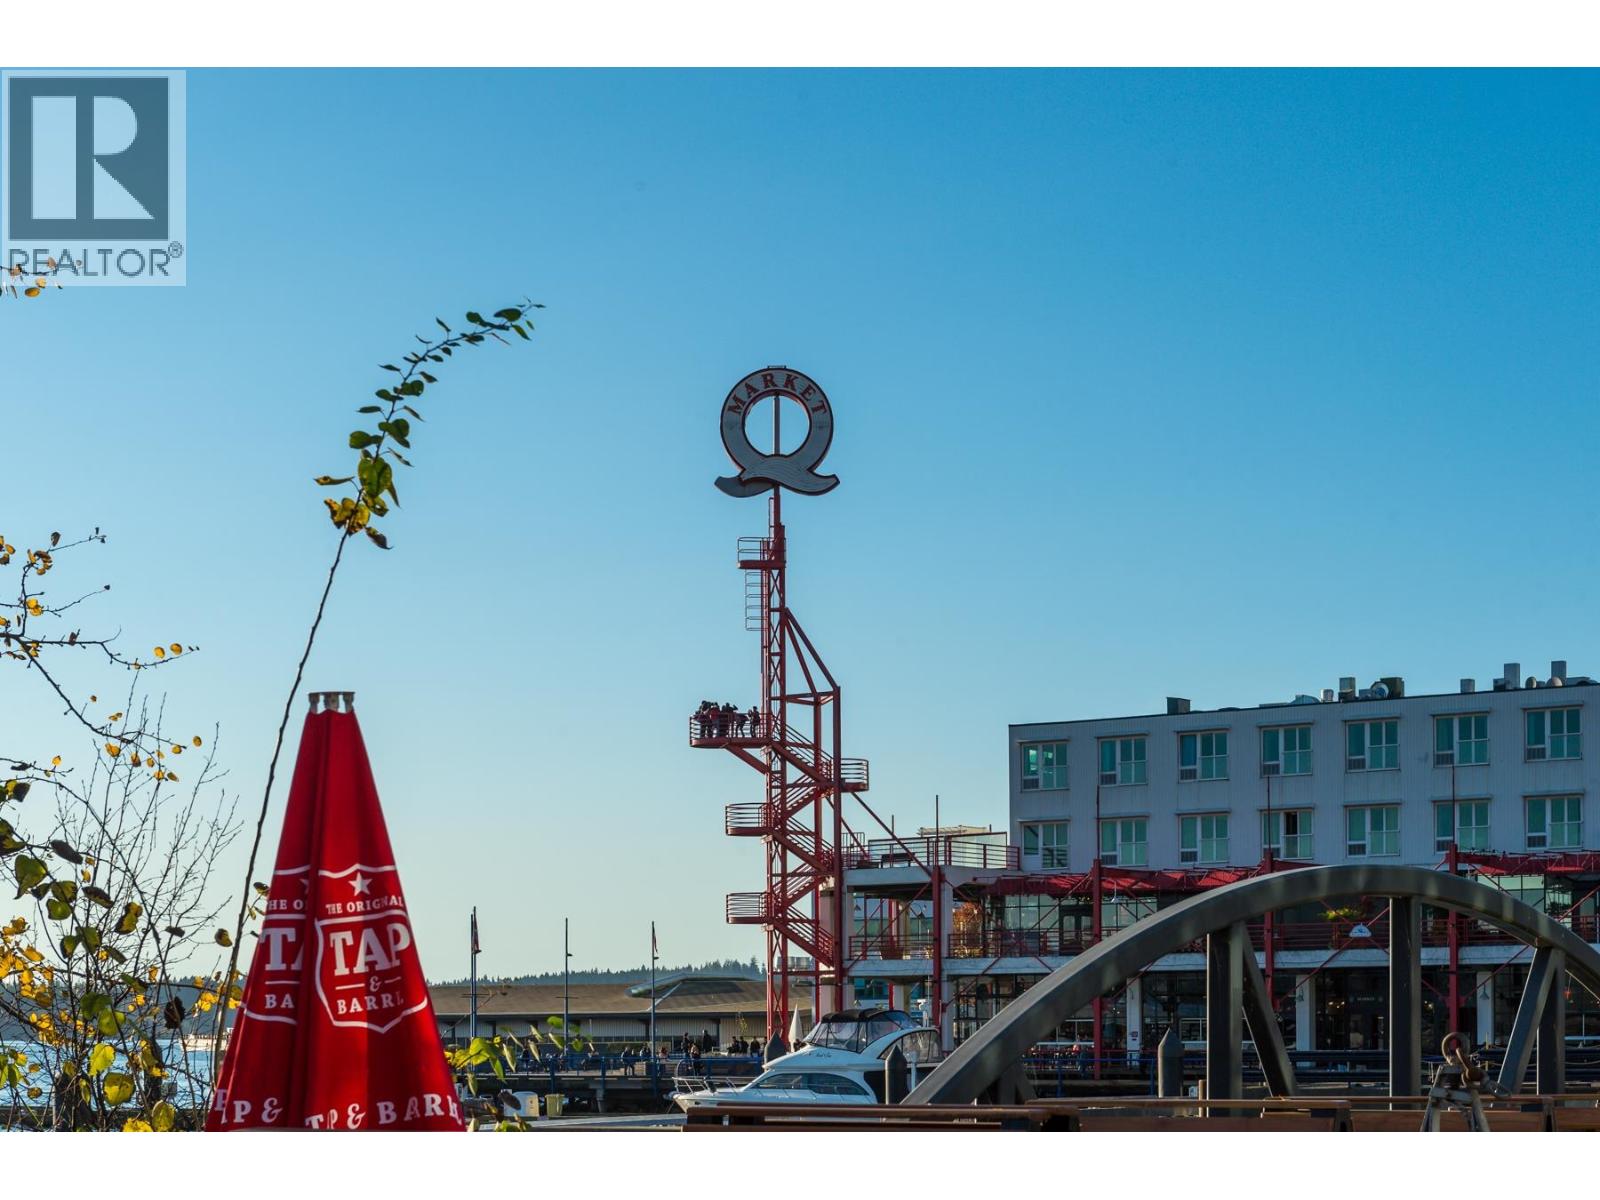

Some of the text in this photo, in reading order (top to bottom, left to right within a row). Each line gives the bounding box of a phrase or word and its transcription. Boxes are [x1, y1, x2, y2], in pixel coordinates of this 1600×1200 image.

[727, 372, 828, 415] MARKET
[268, 899, 288, 911] HE
[329, 922, 410, 976] TAP
[369, 976, 380, 992] &
[261, 1097, 283, 1123] &
[347, 1103, 366, 1130] &
